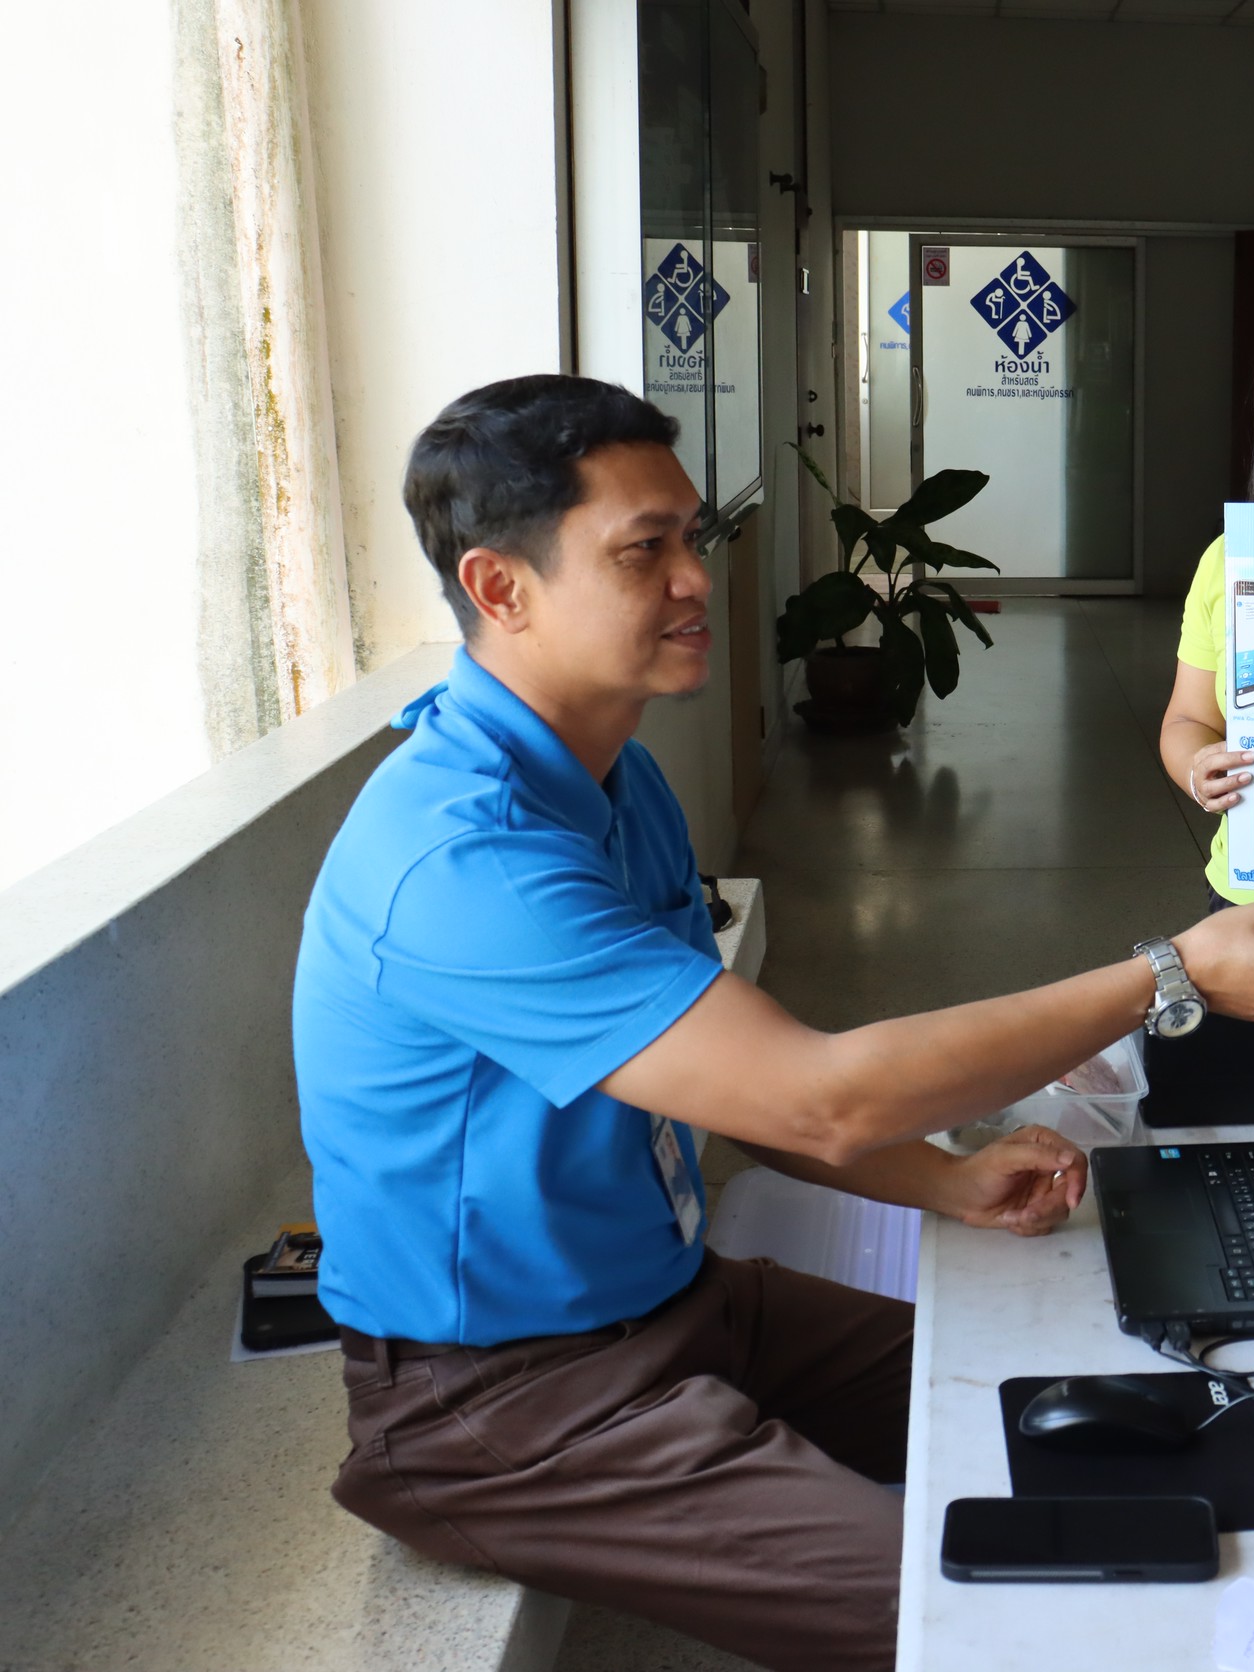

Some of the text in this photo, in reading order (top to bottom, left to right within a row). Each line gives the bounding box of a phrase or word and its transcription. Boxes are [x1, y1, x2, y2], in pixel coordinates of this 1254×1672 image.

[995, 351, 1050, 373] ห้องน้ำ
[1001, 374, 1039, 386] สำหรับสตรี
[1207, 1380, 1230, 1406] acer
